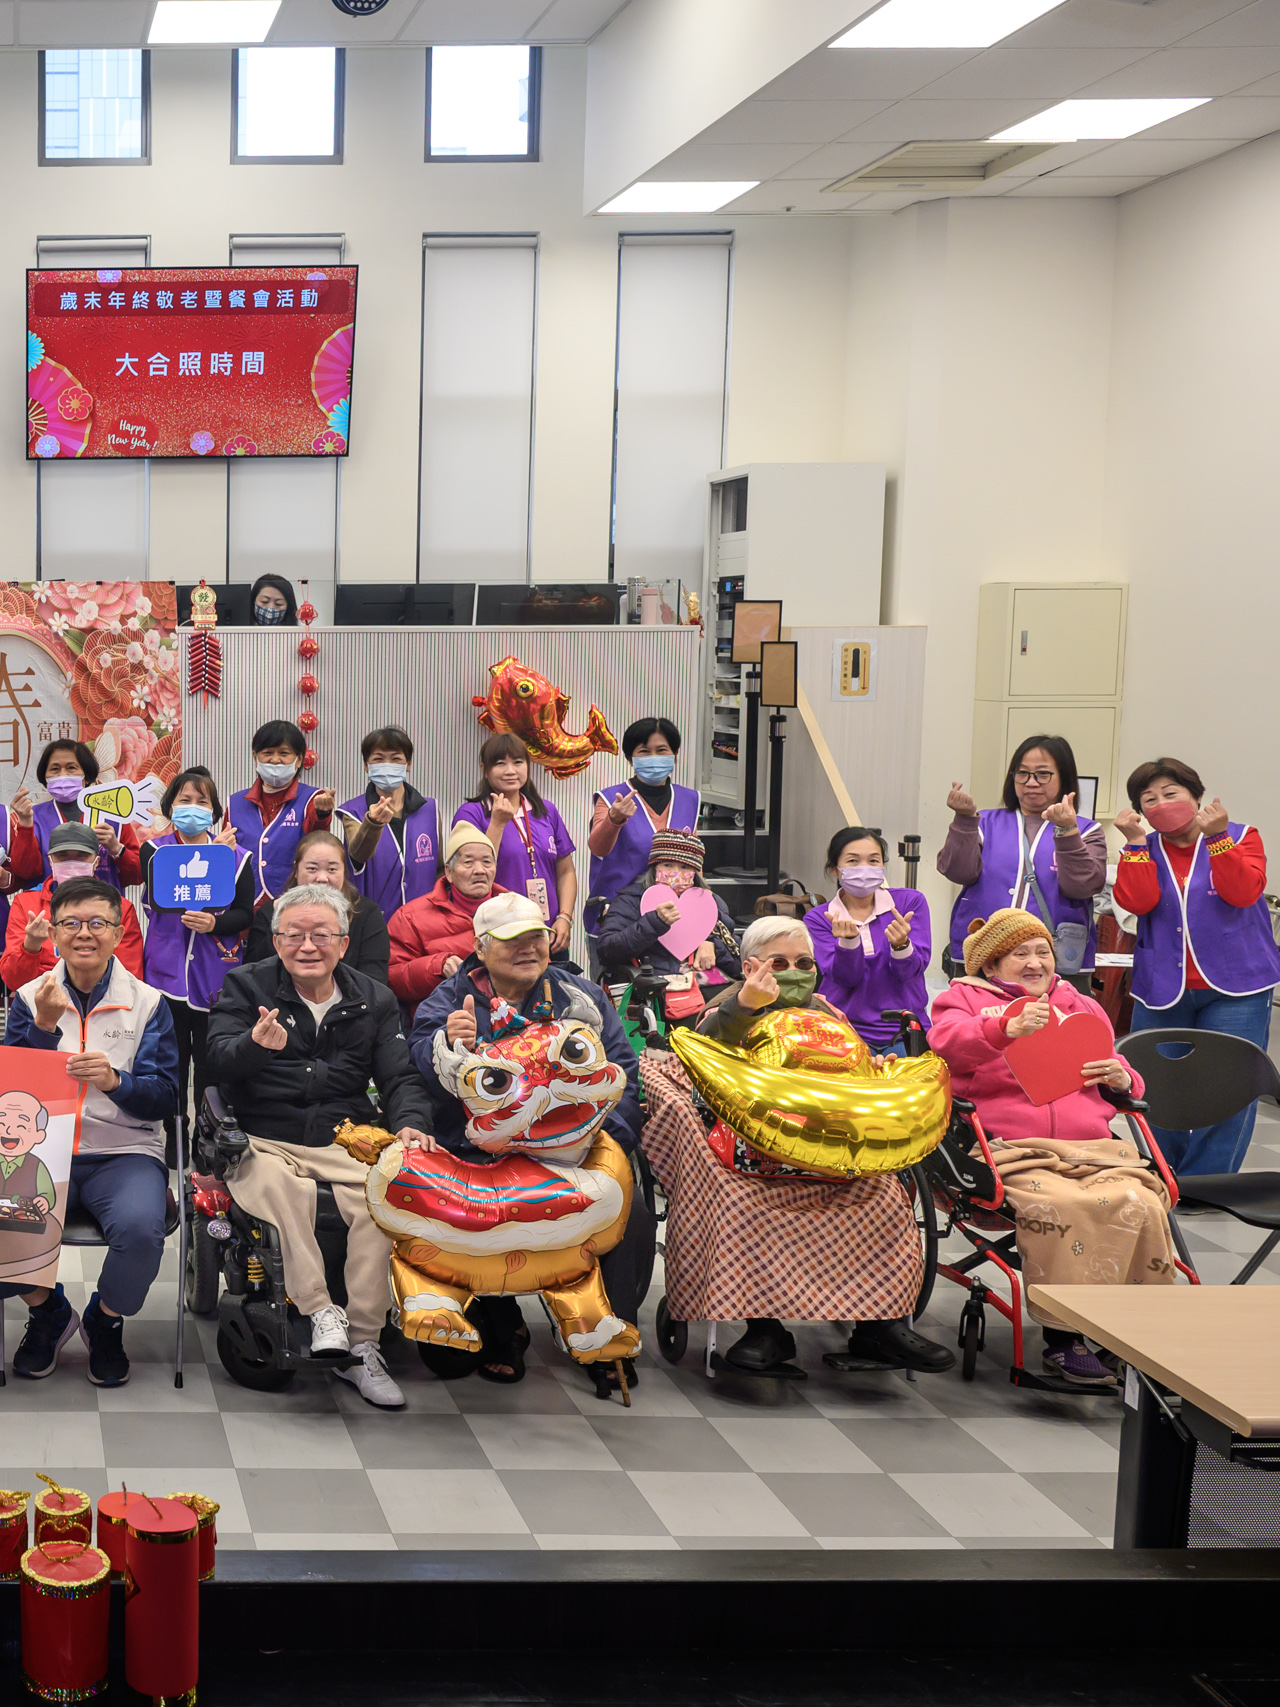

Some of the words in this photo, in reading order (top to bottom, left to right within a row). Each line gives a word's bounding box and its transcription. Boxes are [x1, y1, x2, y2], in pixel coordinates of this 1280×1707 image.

[60, 289, 319, 310] 歲末年終敬老暨餐會活動
[115, 351, 265, 377] 大合照時間
[120, 419, 147, 437] Happy
[107, 433, 129, 445] New
[37, 721, 72, 742] 富貴
[173, 883, 212, 902] 推薦
